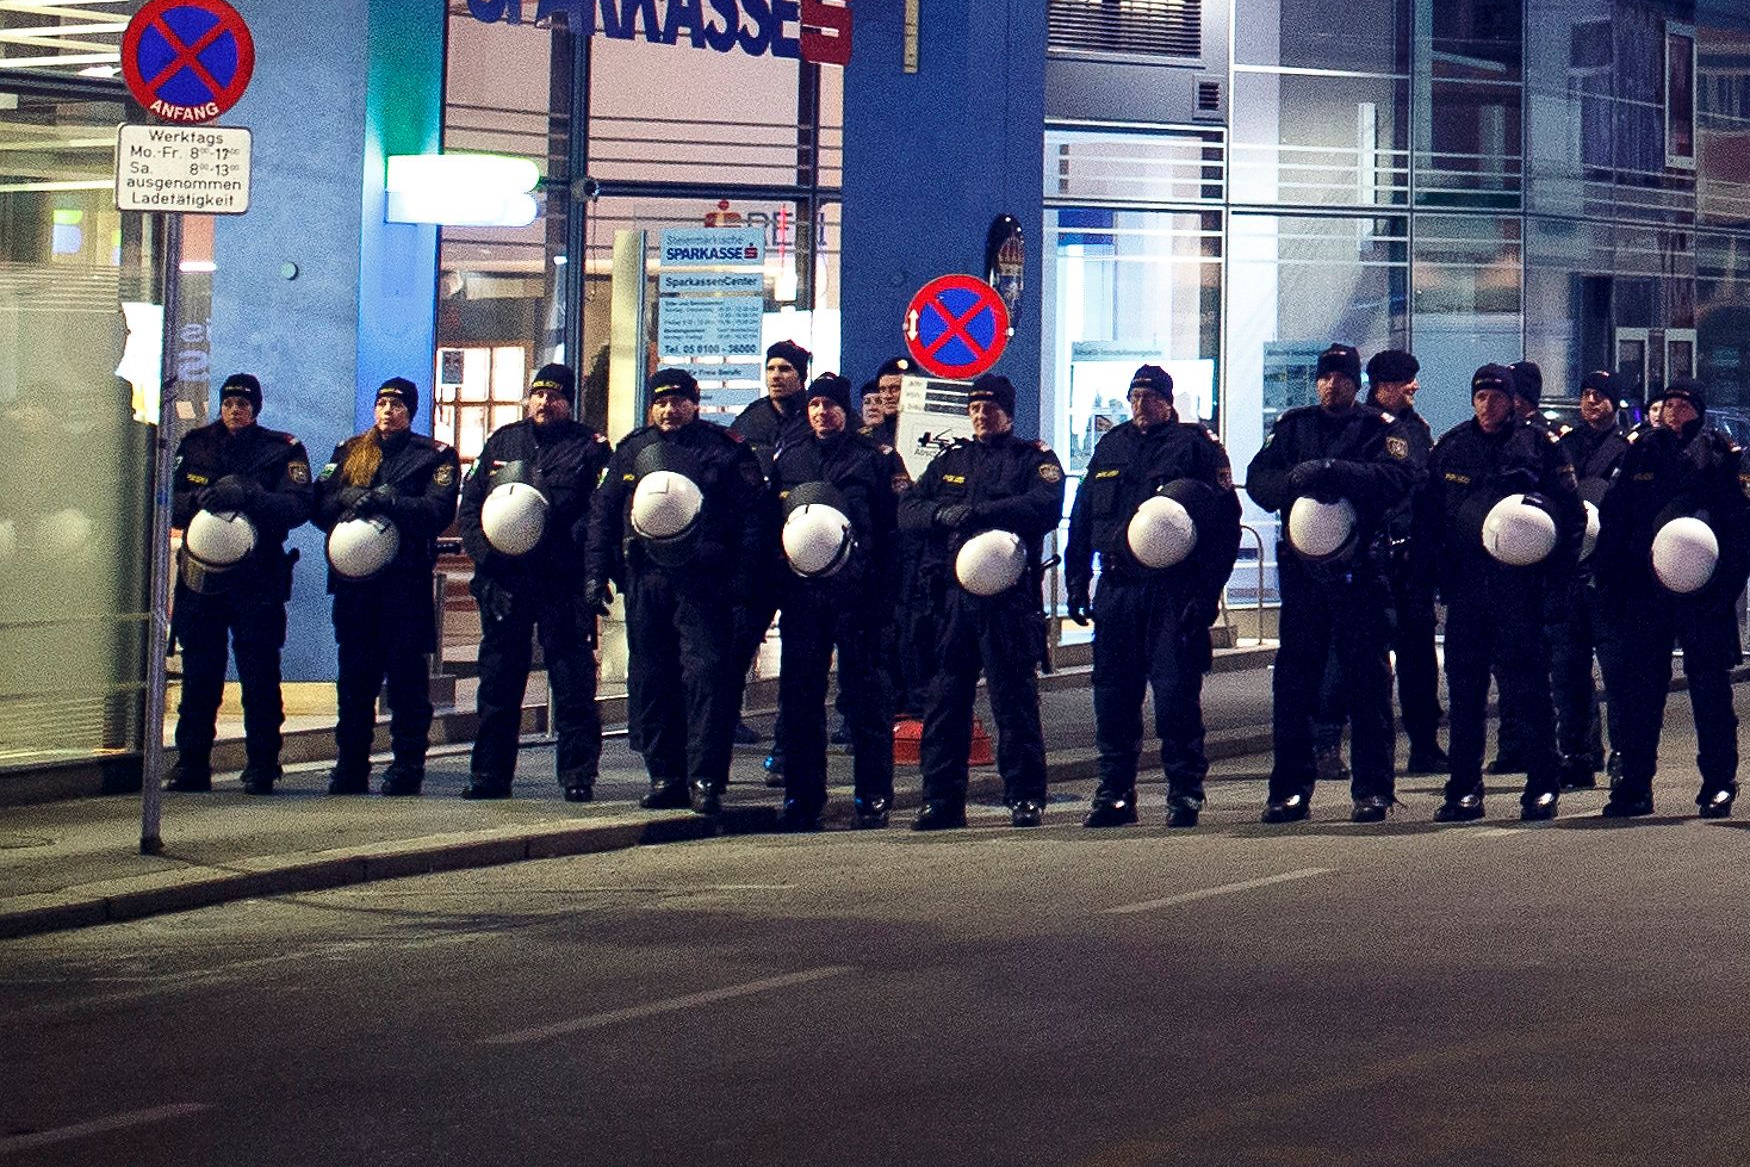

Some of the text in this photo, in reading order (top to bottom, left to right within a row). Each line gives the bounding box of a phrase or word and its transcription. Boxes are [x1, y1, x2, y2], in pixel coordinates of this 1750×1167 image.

[150, 99, 219, 121] ANFANG
[148, 130, 224, 147] Werktags
[126, 177, 241, 191] ausgenommen
[132, 192, 234, 208] Ladetätigkeit
[666, 246, 744, 261] SPARKASSE
